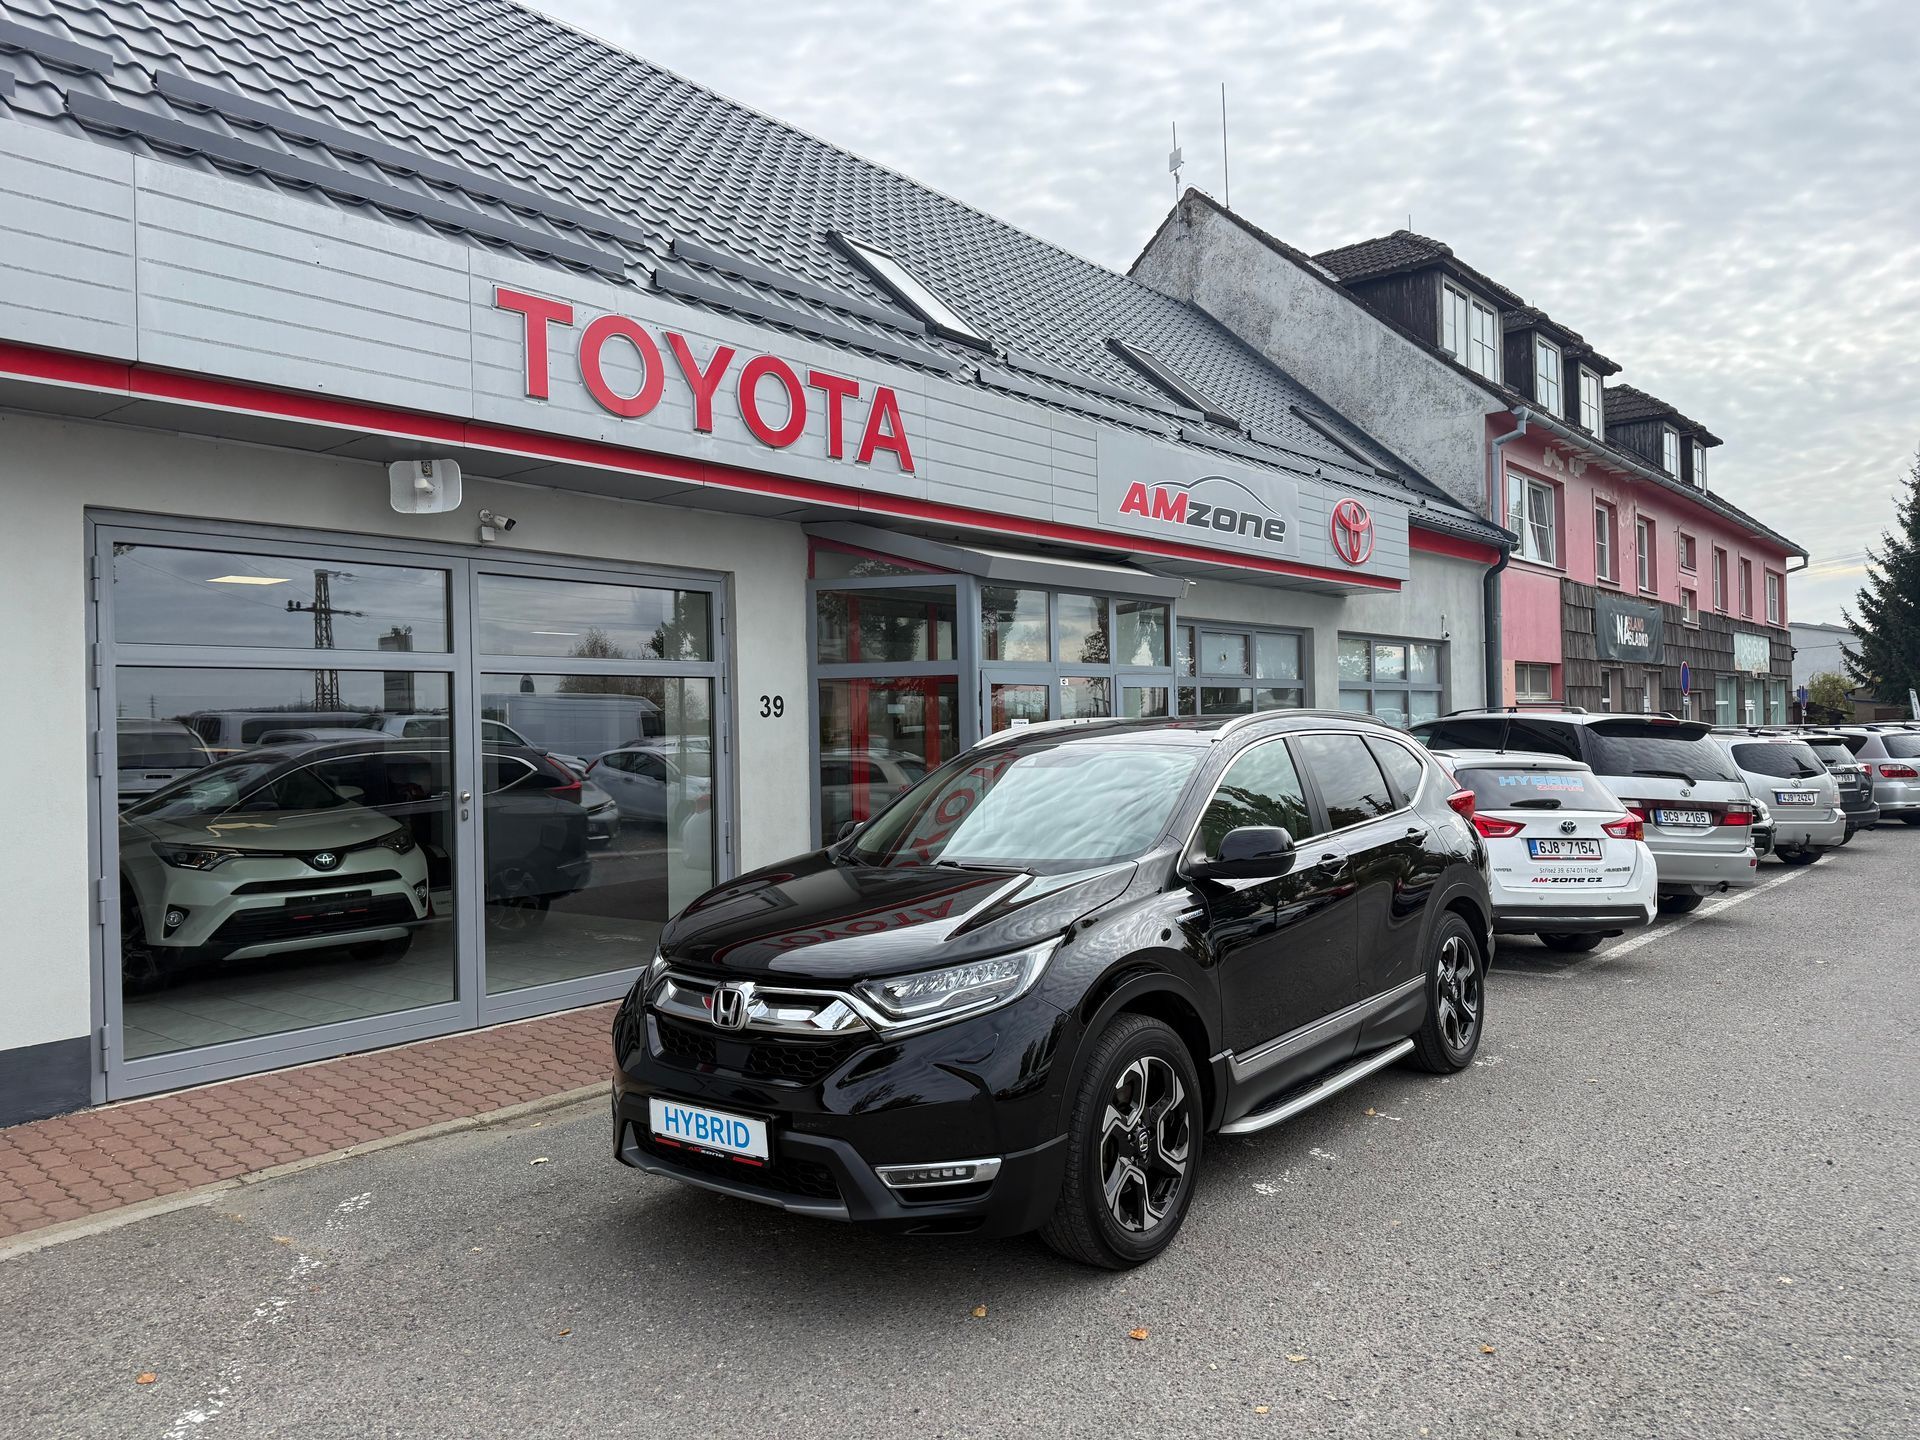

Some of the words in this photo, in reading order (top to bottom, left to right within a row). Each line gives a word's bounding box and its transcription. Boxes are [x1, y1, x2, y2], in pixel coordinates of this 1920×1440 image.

[494, 285, 915, 474] TOYOTA
[1118, 480, 1287, 543] AMzone
[1616, 614, 1629, 645] NA
[760, 695, 785, 718] 39
[1498, 775, 1584, 788] HYBRID
[1798, 793, 1812, 802] 2424
[1663, 811, 1679, 821] 9C9
[1685, 812, 1706, 823] 2165
[1540, 841, 1560, 854] 6J8
[1567, 841, 1595, 854] 7154
[664, 1106, 750, 1149] HYBRID
